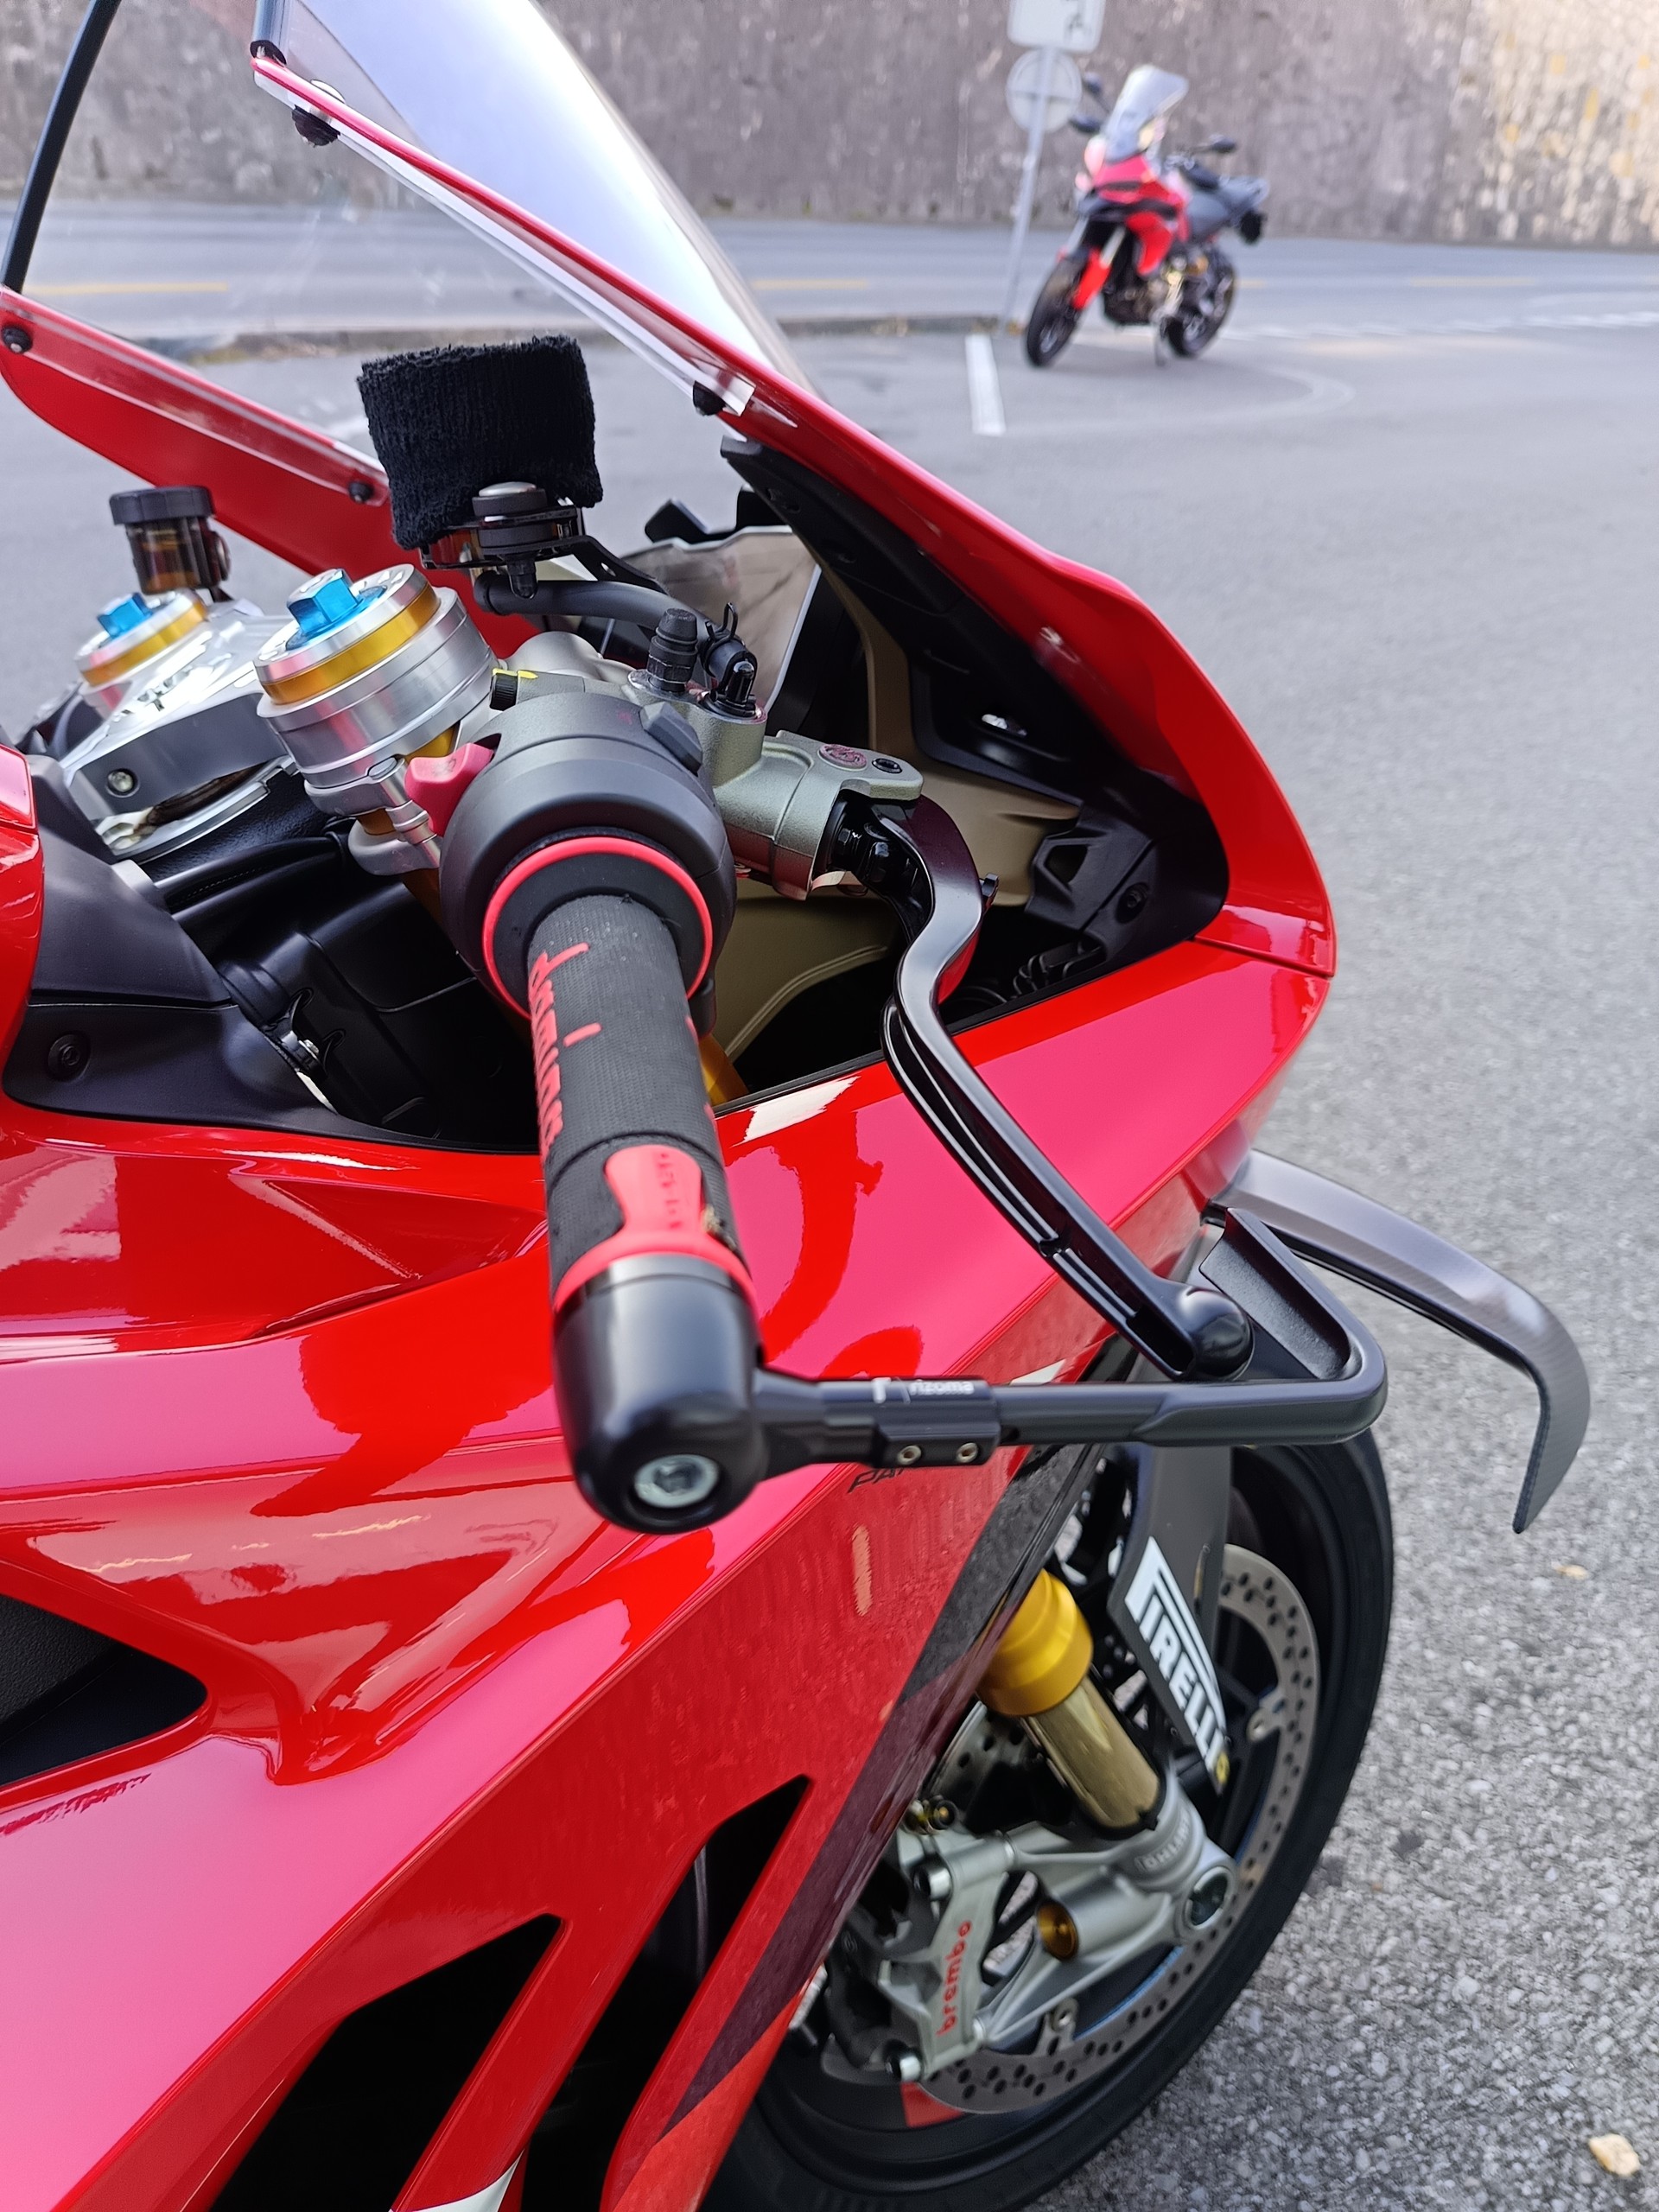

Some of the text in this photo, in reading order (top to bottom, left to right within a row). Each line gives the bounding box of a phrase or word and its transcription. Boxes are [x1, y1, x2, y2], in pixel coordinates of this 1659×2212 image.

[908, 1379, 975, 1396] rizoma
[1124, 1535, 1226, 1772] PIRELLI
[936, 1920, 972, 2037] brembo
